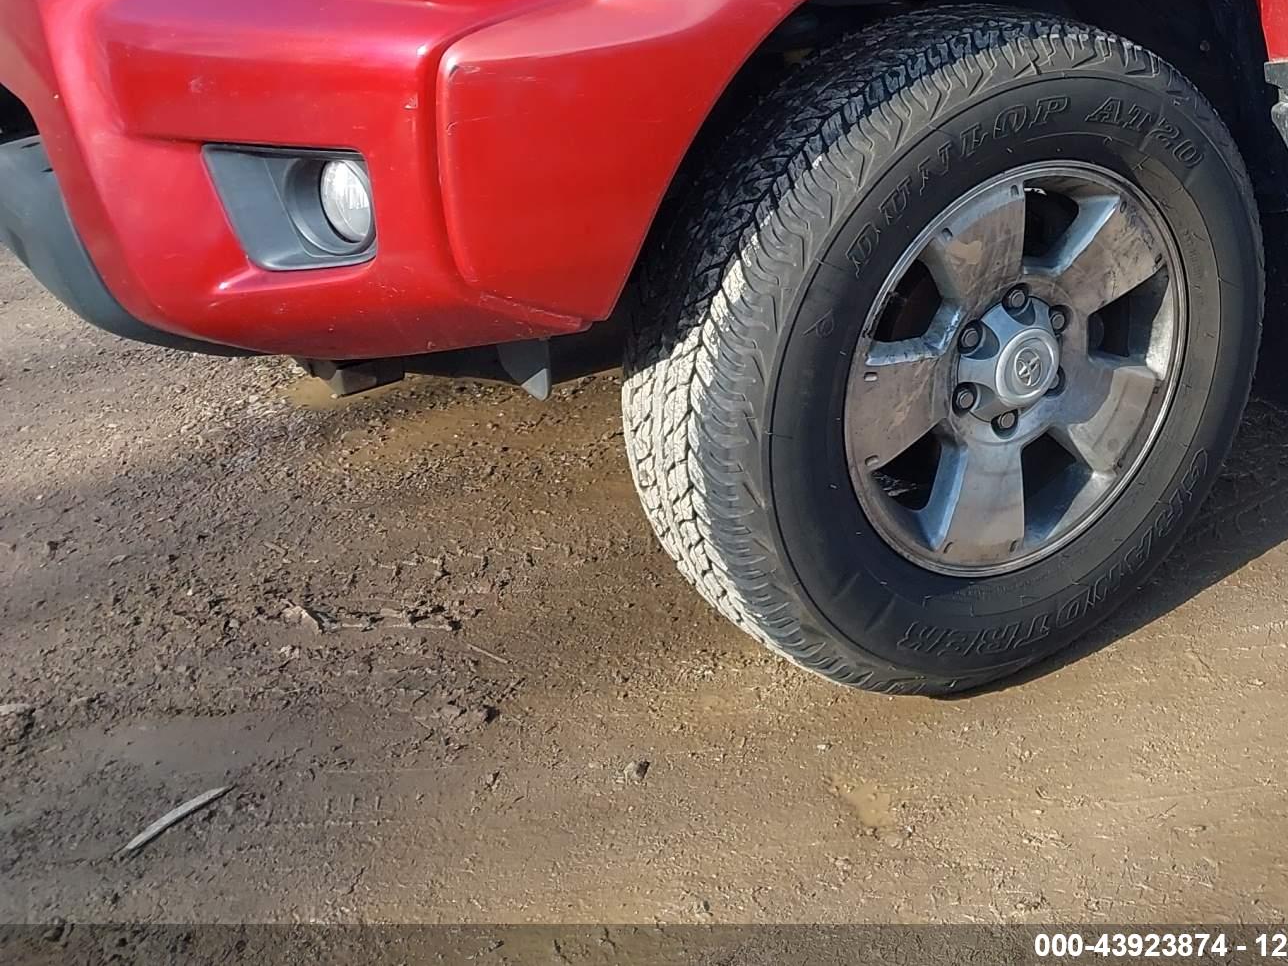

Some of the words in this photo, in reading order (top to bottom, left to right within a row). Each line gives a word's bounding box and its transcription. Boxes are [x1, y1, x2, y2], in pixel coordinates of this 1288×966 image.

[844, 94, 1069, 279] DUNLOP
[1085, 96, 1206, 169] AT20
[896, 447, 1209, 656] GRANDTREK
